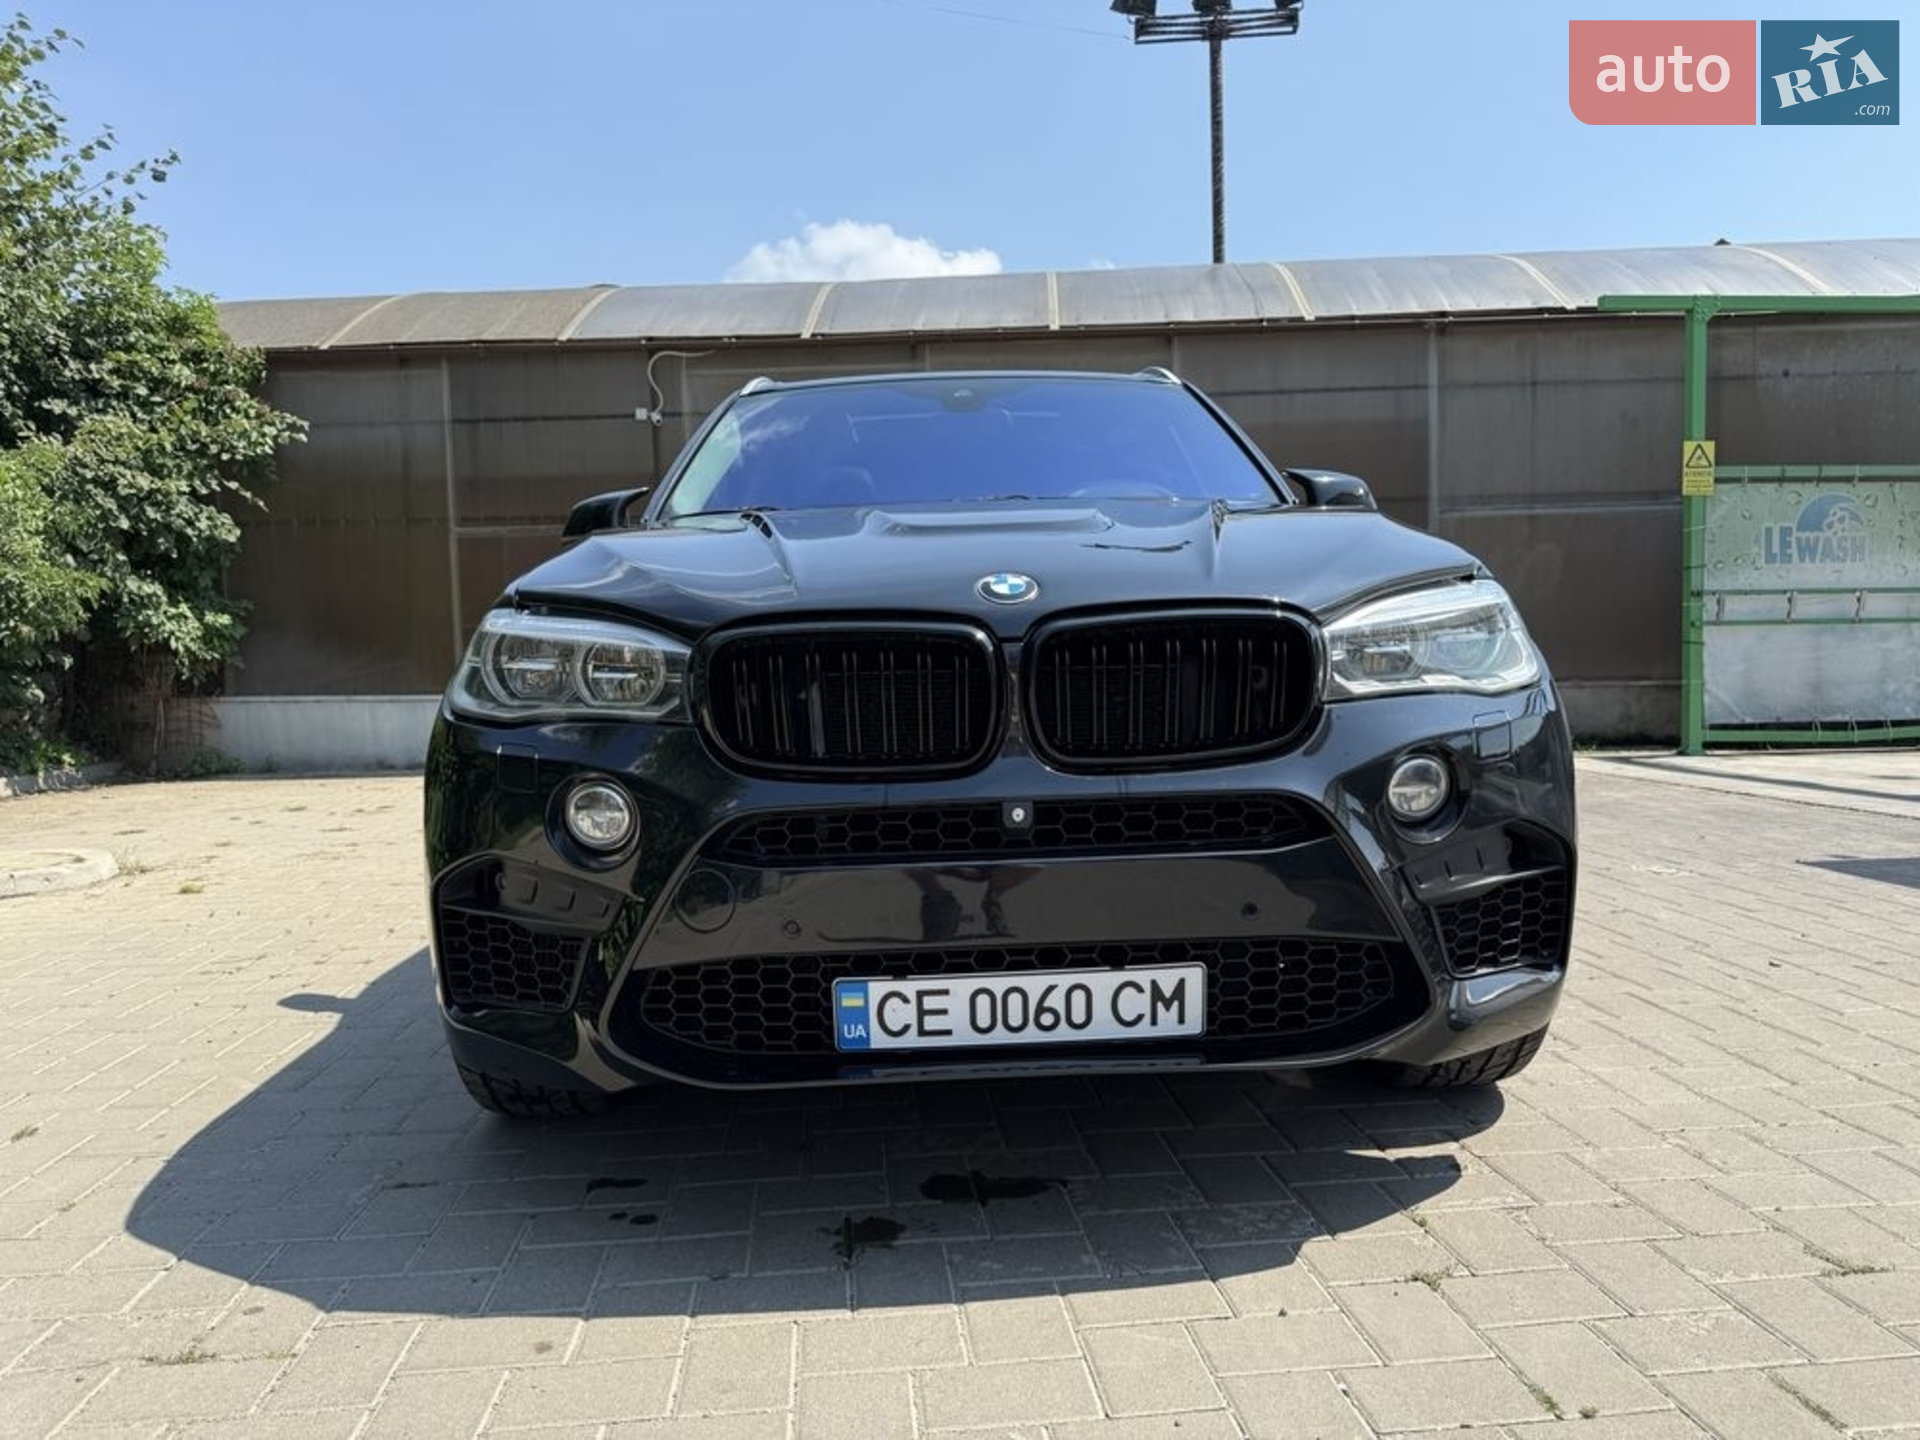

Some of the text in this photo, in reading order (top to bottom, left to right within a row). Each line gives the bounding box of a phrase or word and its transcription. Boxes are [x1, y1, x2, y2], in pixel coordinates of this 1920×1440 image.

[876, 977, 1186, 1038] CE 0060 CM
[844, 1024, 867, 1038] UA
